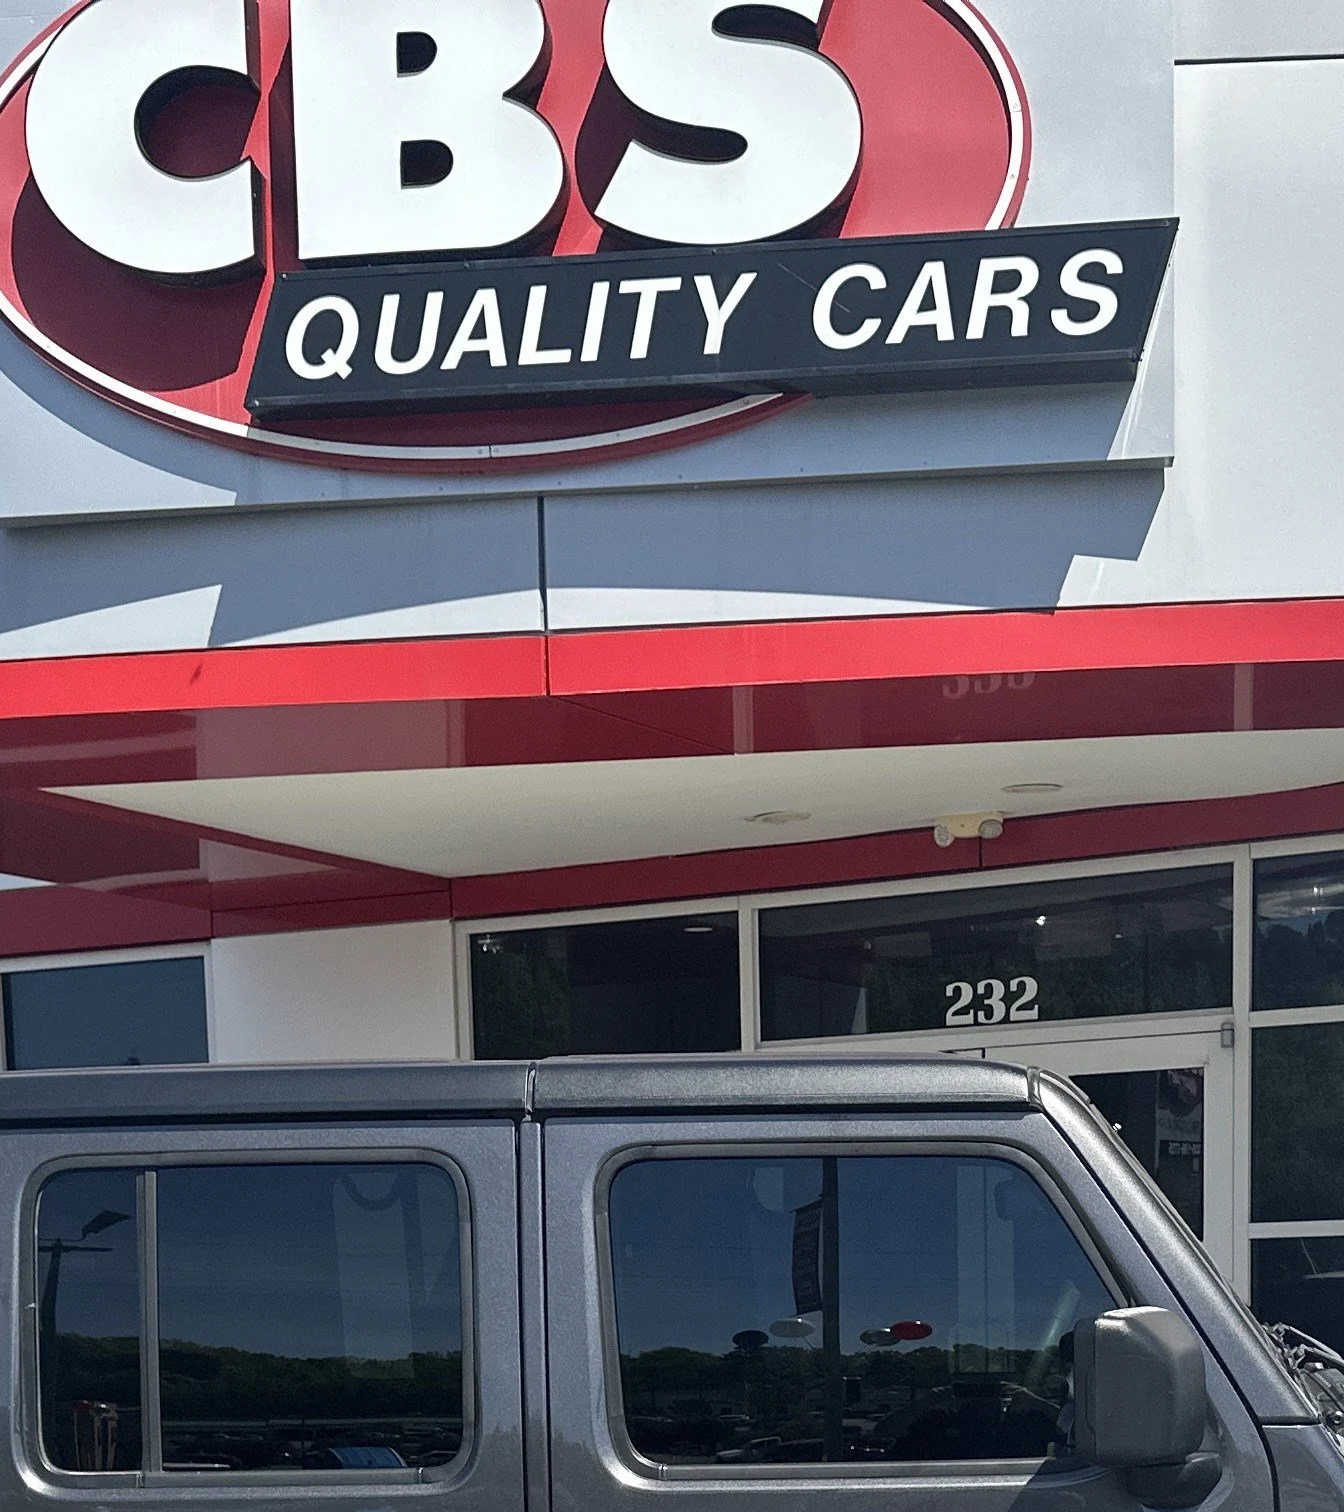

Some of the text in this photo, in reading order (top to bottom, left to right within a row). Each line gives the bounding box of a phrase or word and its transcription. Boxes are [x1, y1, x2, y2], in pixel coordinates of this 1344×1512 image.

[23, 0, 861, 274] CBS
[284, 248, 1126, 382] QUALITY CARS
[945, 975, 1040, 1026] 232
